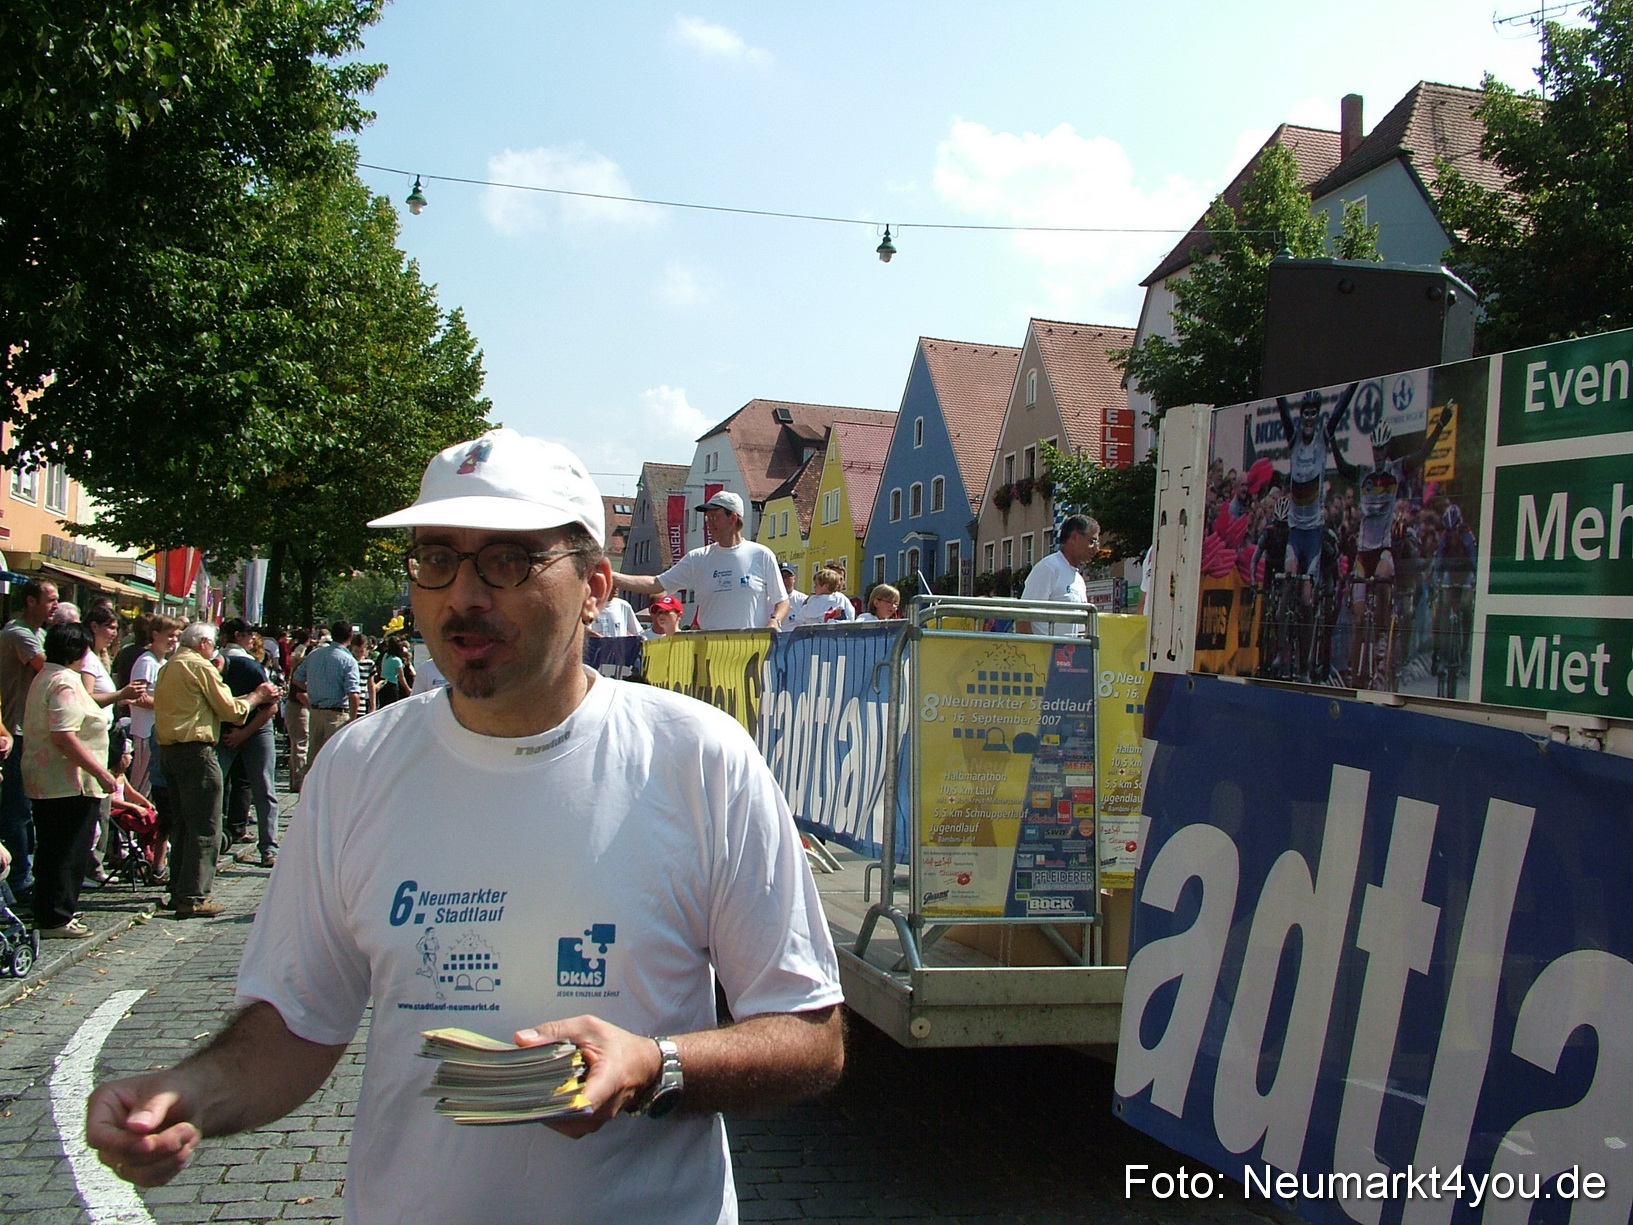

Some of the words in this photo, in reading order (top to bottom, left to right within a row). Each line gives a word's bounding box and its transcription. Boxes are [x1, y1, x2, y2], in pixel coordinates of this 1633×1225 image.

[1524, 359, 1629, 413] Even
[1515, 483, 1633, 561] Meh
[1505, 634, 1610, 697] Miet
[1100, 670, 1120, 698] 8.
[1115, 672, 1144, 684] Neu
[1126, 689, 1140, 699] 16.
[921, 693, 945, 722] 8.
[941, 695, 1025, 710] Neumarkter
[1028, 697, 1093, 713] Stadtlauf
[952, 713, 968, 723] 16.
[972, 713, 1032, 726] September
[1035, 715, 1061, 726] 2007
[1111, 758, 1127, 769] 10,5
[944, 771, 1007, 783] Halbmarathon
[1105, 779, 1118, 789] 5,5
[1119, 779, 1132, 789] km
[939, 785, 955, 797] 10,5
[956, 785, 973, 796] km
[974, 785, 996, 796] Lauf
[933, 807, 948, 820] 5,5
[948, 807, 964, 819] km
[965, 807, 1030, 822] Schnupperlauf
[929, 822, 979, 835] Jugendlauf
[1034, 870, 1093, 883] PFLEIDERER
[389, 880, 426, 927] 6.
[418, 888, 508, 907] Neumarkter
[1029, 897, 1074, 910] BOCK
[434, 906, 505, 924] Stadtlauf
[559, 970, 604, 986] DKMS
[556, 990, 573, 998] JEDER
[397, 1002, 501, 1012] www.stadtlauf-neumarkt.de
